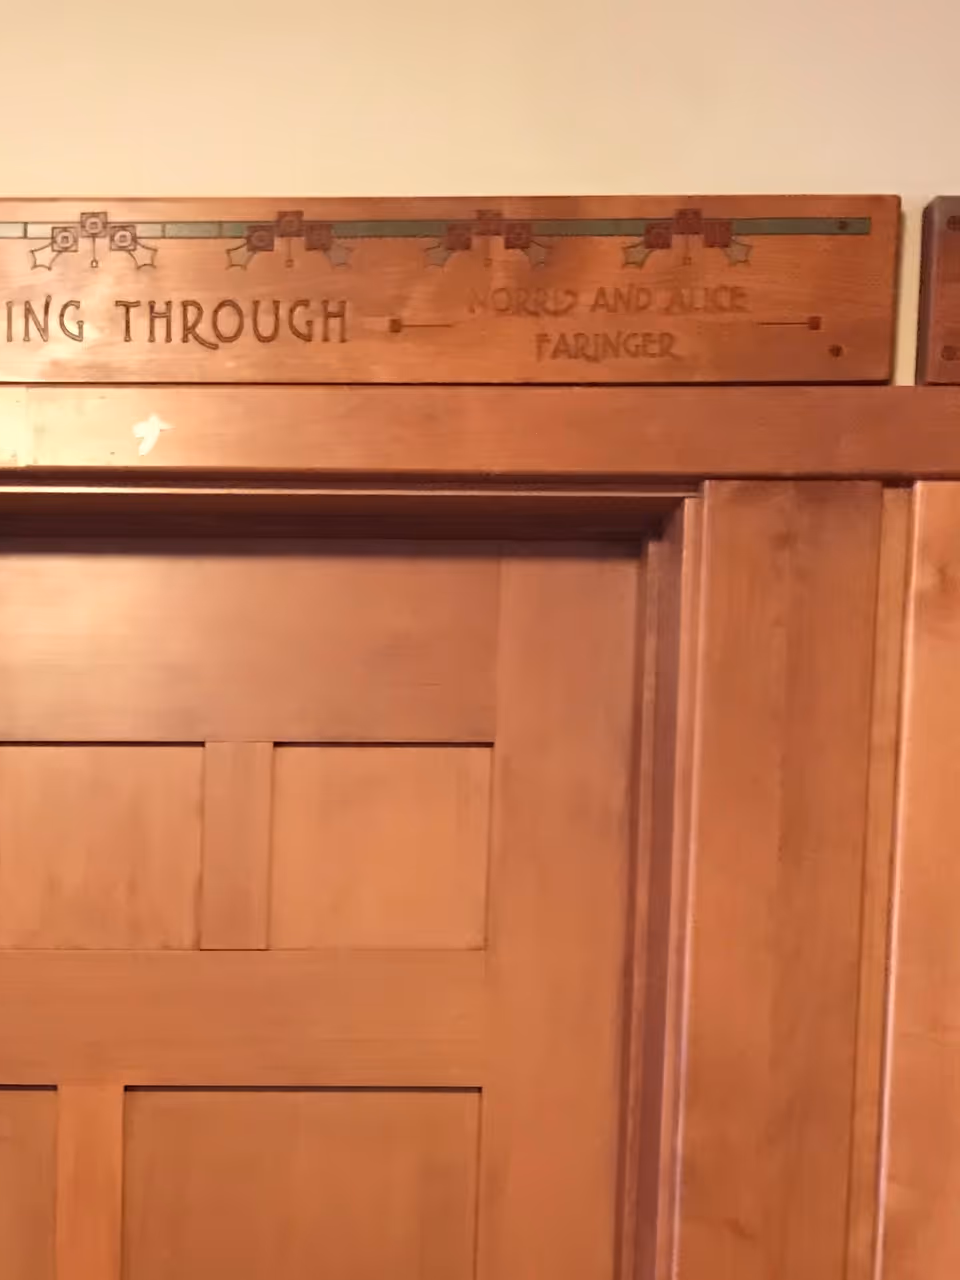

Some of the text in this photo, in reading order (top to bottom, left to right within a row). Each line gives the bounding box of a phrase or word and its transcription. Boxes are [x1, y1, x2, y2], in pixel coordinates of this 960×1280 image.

[590, 285, 652, 313] AND
[665, 285, 750, 314] ALICE
[115, 299, 347, 349] THROUGH
[535, 332, 683, 363] FARINGER
